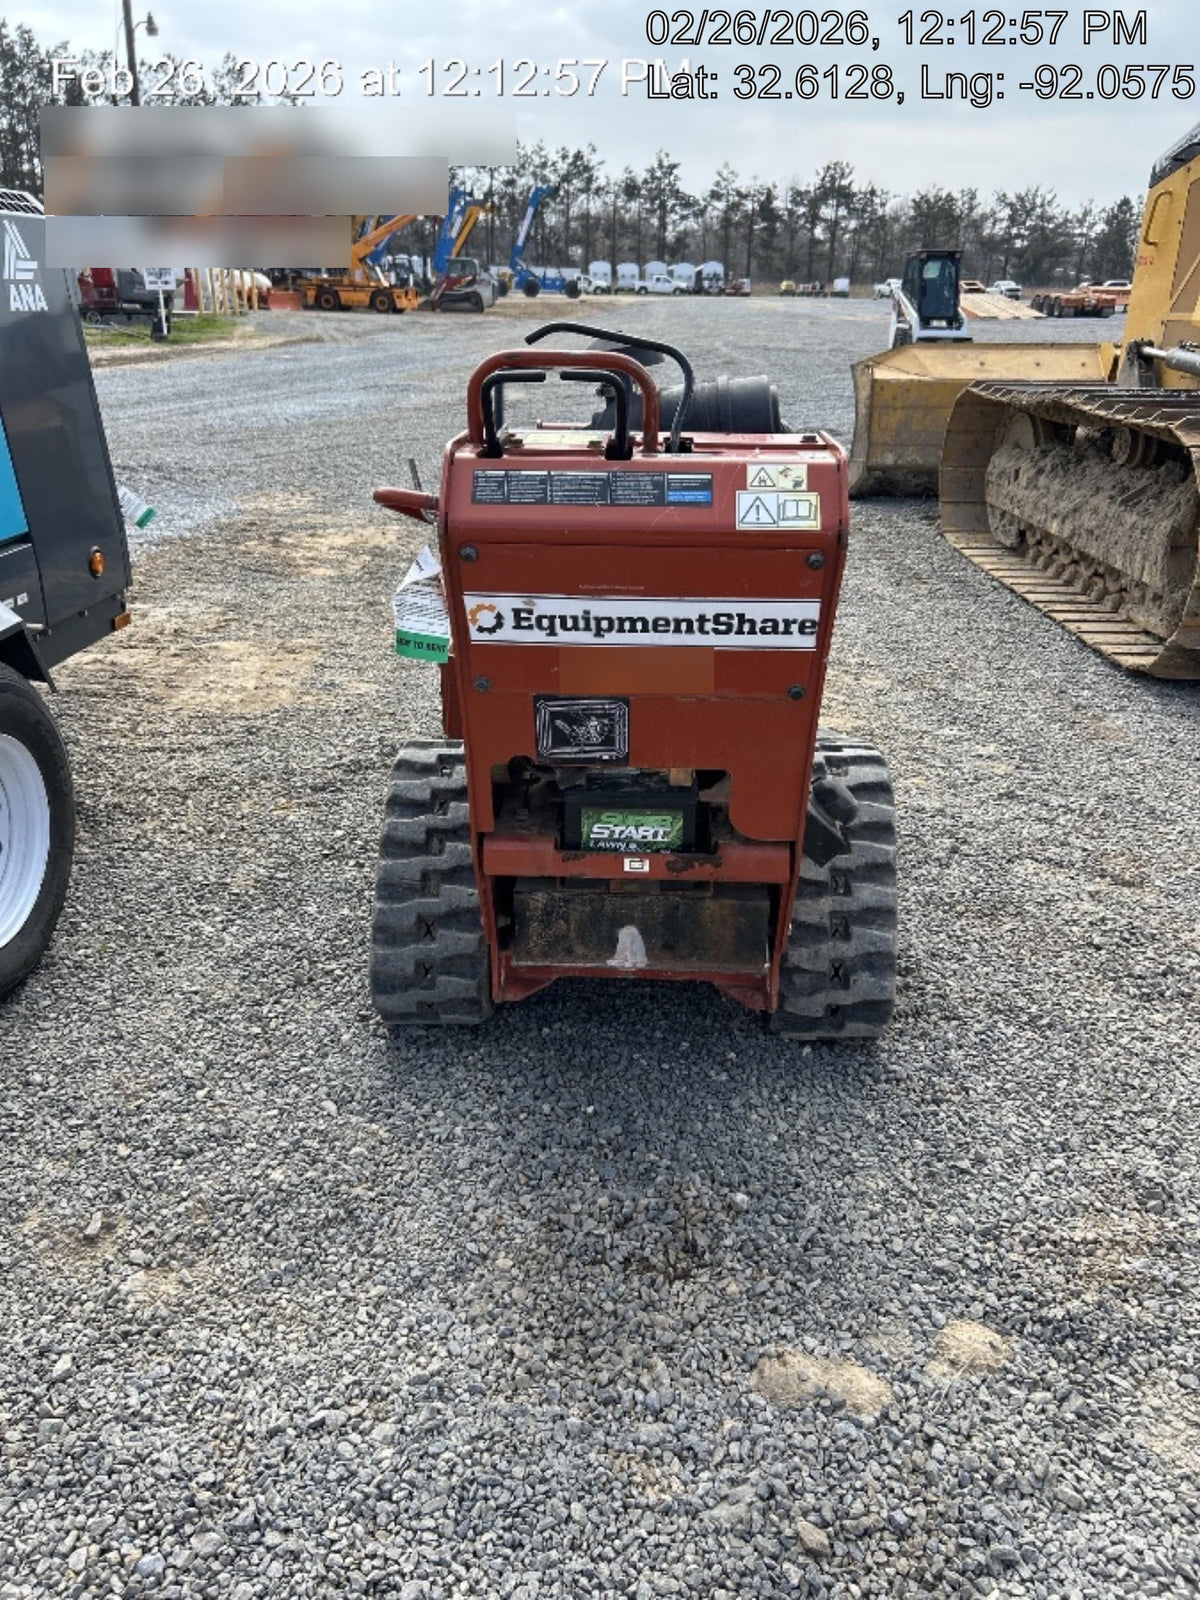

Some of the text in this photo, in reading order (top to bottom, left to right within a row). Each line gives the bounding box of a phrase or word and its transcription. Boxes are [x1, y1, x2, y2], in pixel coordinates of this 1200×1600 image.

[10, 284, 48, 311] ANA
[512, 607, 818, 638] EquipmentShare
[589, 823, 671, 841] START
